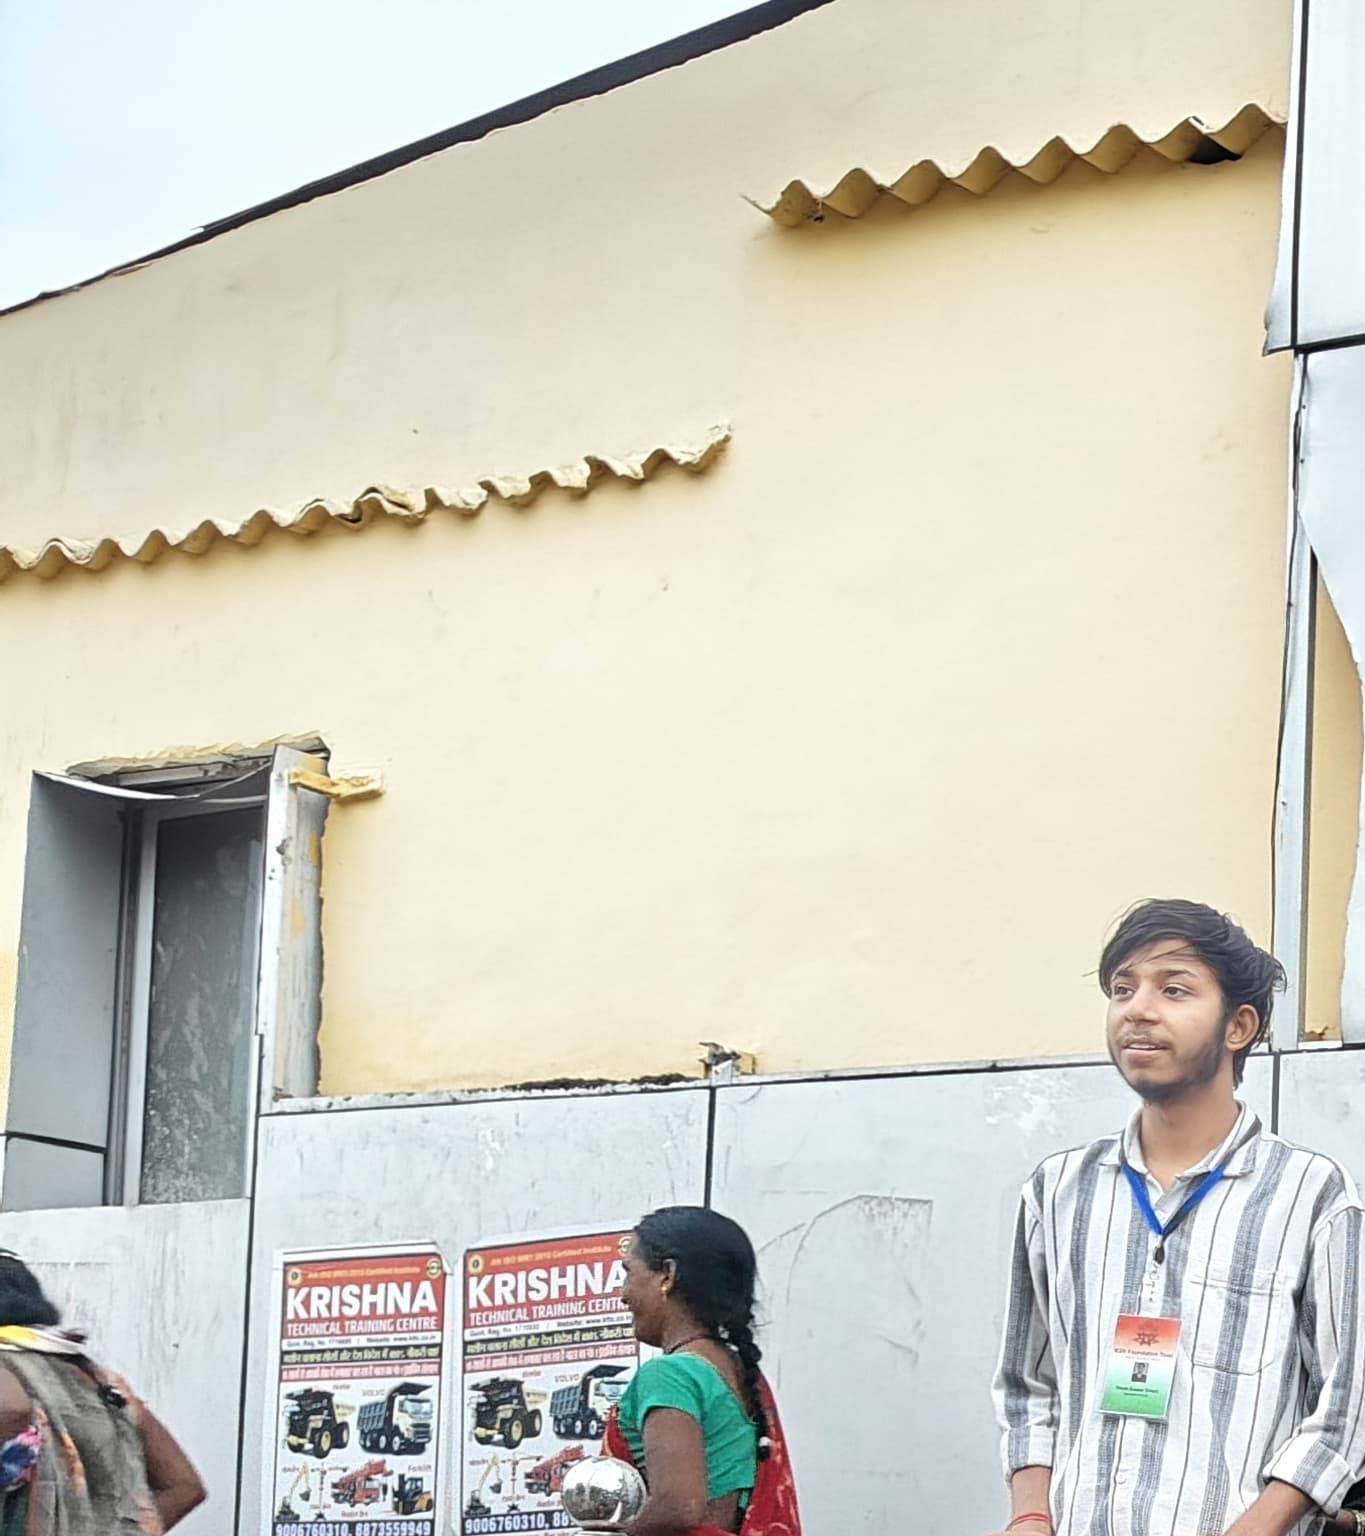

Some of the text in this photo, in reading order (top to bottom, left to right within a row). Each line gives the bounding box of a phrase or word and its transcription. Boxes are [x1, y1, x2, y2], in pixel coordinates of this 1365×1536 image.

[468, 1260, 628, 1309] KRISHNA
[287, 1280, 438, 1319] KRISHNA
[470, 1309, 529, 1326] TECHNICAL
[532, 1301, 586, 1321] TRAINING
[287, 1317, 437, 1337] TECHNICAL TRAINING CENTRE
[465, 1513, 550, 1534] 9006760310,
